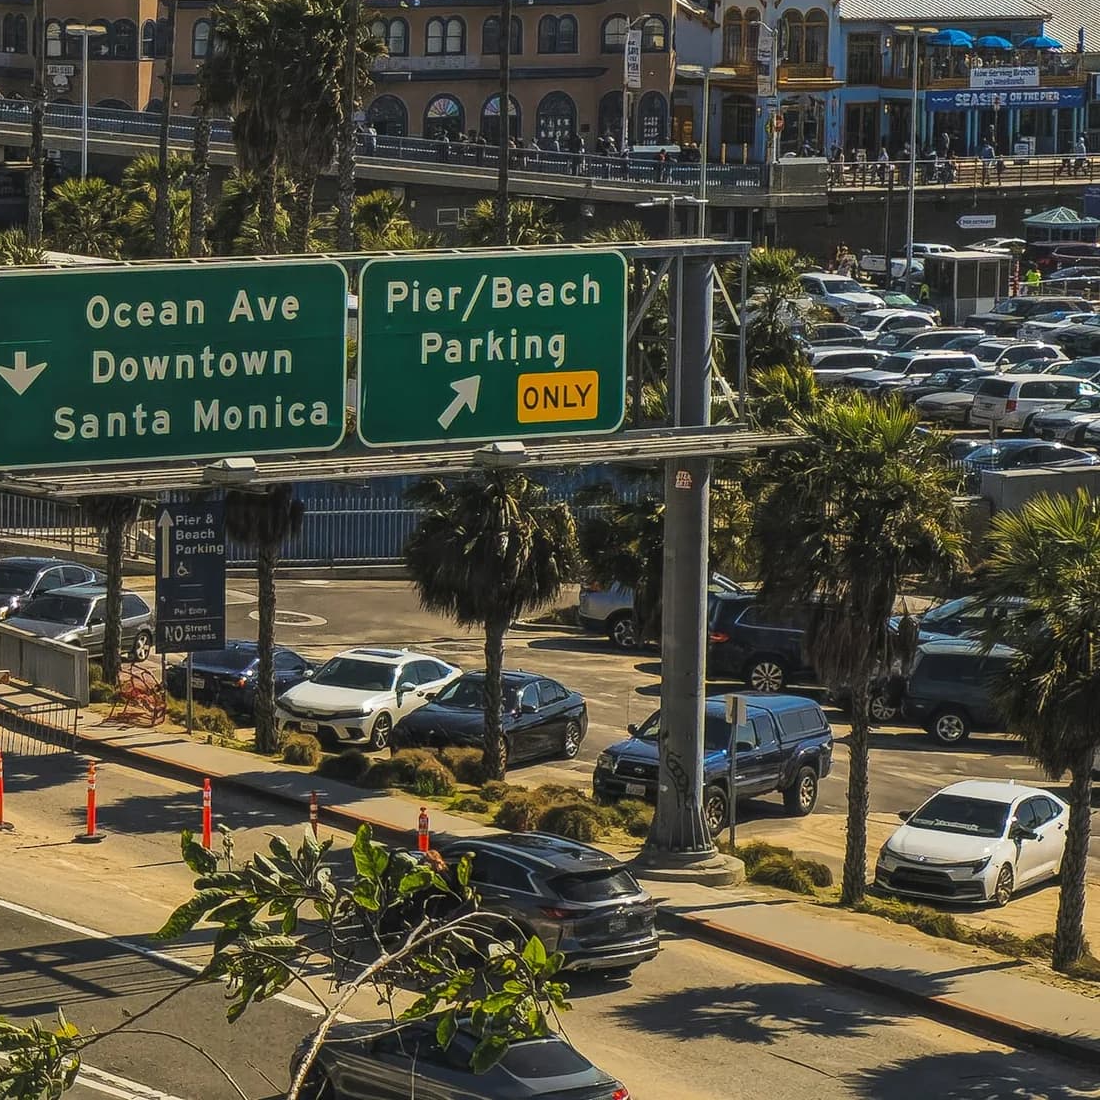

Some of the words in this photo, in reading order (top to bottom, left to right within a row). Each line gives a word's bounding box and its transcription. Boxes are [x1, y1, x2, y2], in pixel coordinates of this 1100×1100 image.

[1010, 92, 1022, 101] ON
[1022, 92, 1040, 101] THE
[1040, 91, 1060, 101] PIER
[387, 273, 600, 322] Pier/Beach
[86, 295, 204, 329] Ocean
[228, 289, 300, 323] Ave
[421, 328, 566, 368] Parking
[92, 346, 292, 384] Downtown
[523, 384, 593, 410] ONLY
[53, 403, 171, 440] Santa
[194, 395, 328, 432] Monica
[175, 515, 201, 526] Pier
[205, 513, 214, 524] &
[175, 528, 215, 540] Beach
[175, 543, 224, 555] Parking
[164, 625, 184, 642] NO
[184, 623, 212, 633] Street
[184, 633, 217, 641] Access
